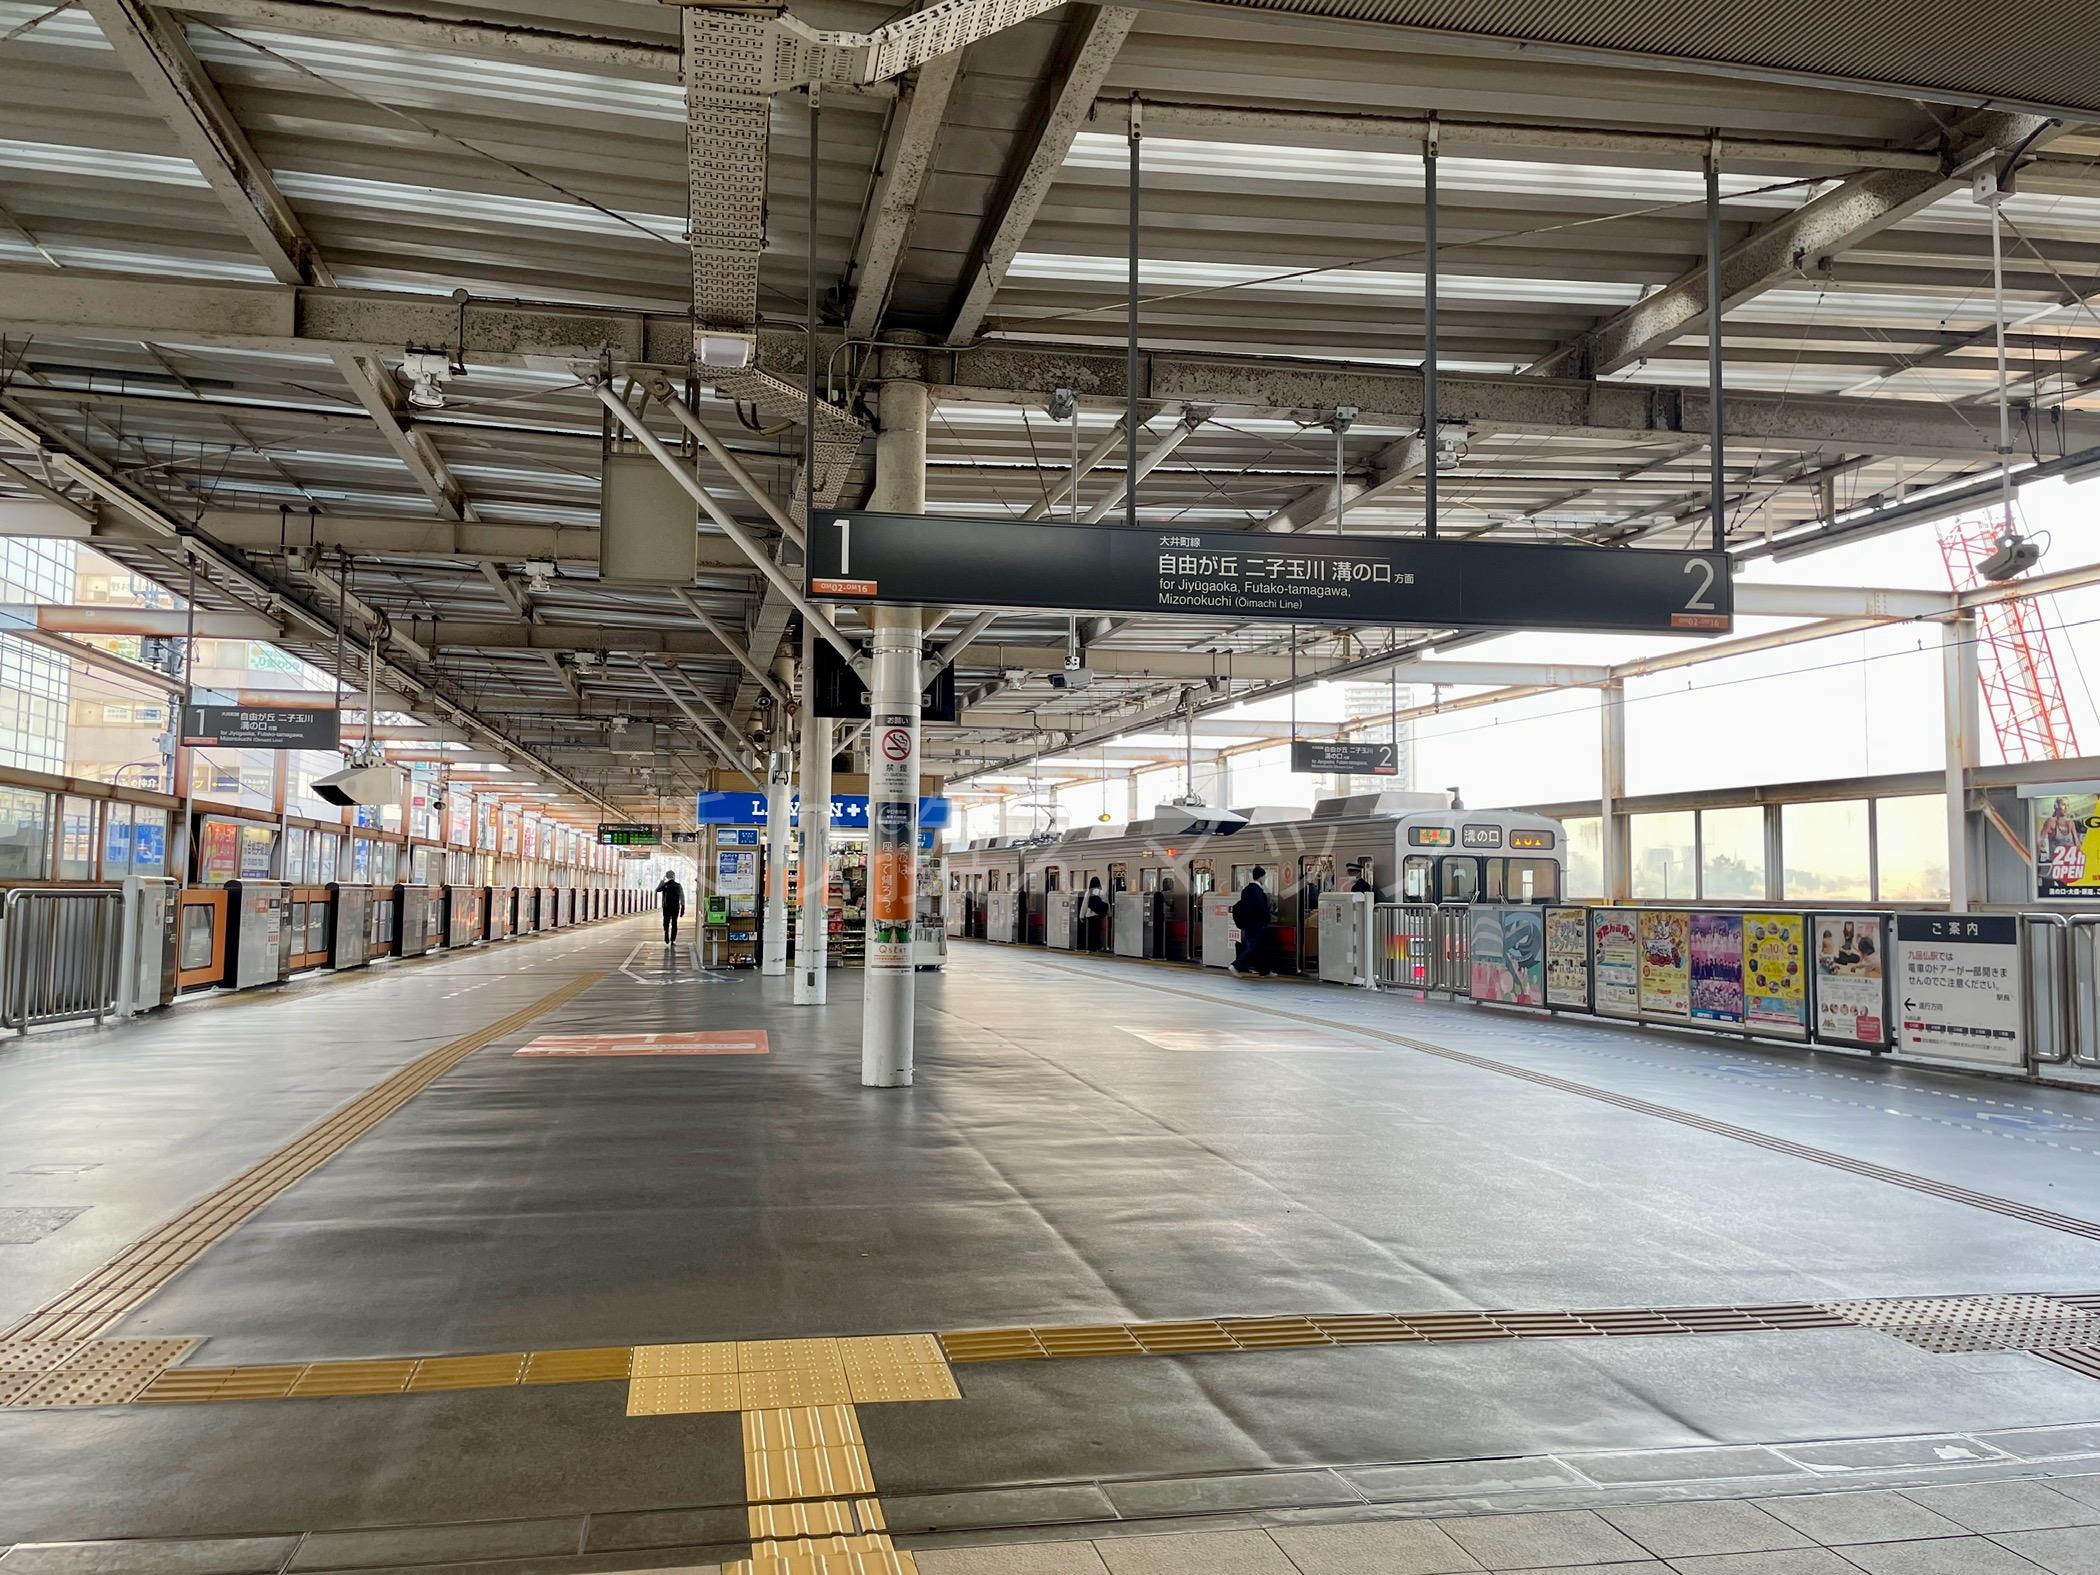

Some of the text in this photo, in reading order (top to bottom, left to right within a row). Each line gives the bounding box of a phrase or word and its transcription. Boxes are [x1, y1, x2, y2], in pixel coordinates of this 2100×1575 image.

[833, 519, 850, 574] 1
[1159, 536, 1201, 548] 大井町線
[1159, 554, 1414, 584] 自由が丘 二子玉川 溝の口 方面
[1160, 578, 1351, 598] for Jiyūgaoka, Futako-tamagawa,
[1684, 558, 1715, 610] 2
[1159, 592, 1231, 607] Mizonokuchi
[1279, 597, 1303, 610] Line)
[196, 709, 205, 736] 1
[240, 712, 276, 722] 自由が丘
[278, 714, 314, 724] 二子玉川
[240, 721, 267, 731] 溝の口
[1380, 746, 1392, 767] 2
[1464, 828, 1499, 843] 溝の口
[2052, 845, 2086, 866] 24h
[881, 841, 893, 913] 座って帰ろう。
[2052, 864, 2085, 880] OPEN
[1932, 921, 1979, 936] ご案内
[1907, 950, 1953, 961] 九品仏駅では
[1908, 962, 2008, 978] 電車のドアーが一部開きま
[1908, 976, 2000, 991] せんのでご注意ください。
[1996, 993, 2011, 1001] 駅長
[1918, 1001, 1943, 1011] 進行方向
